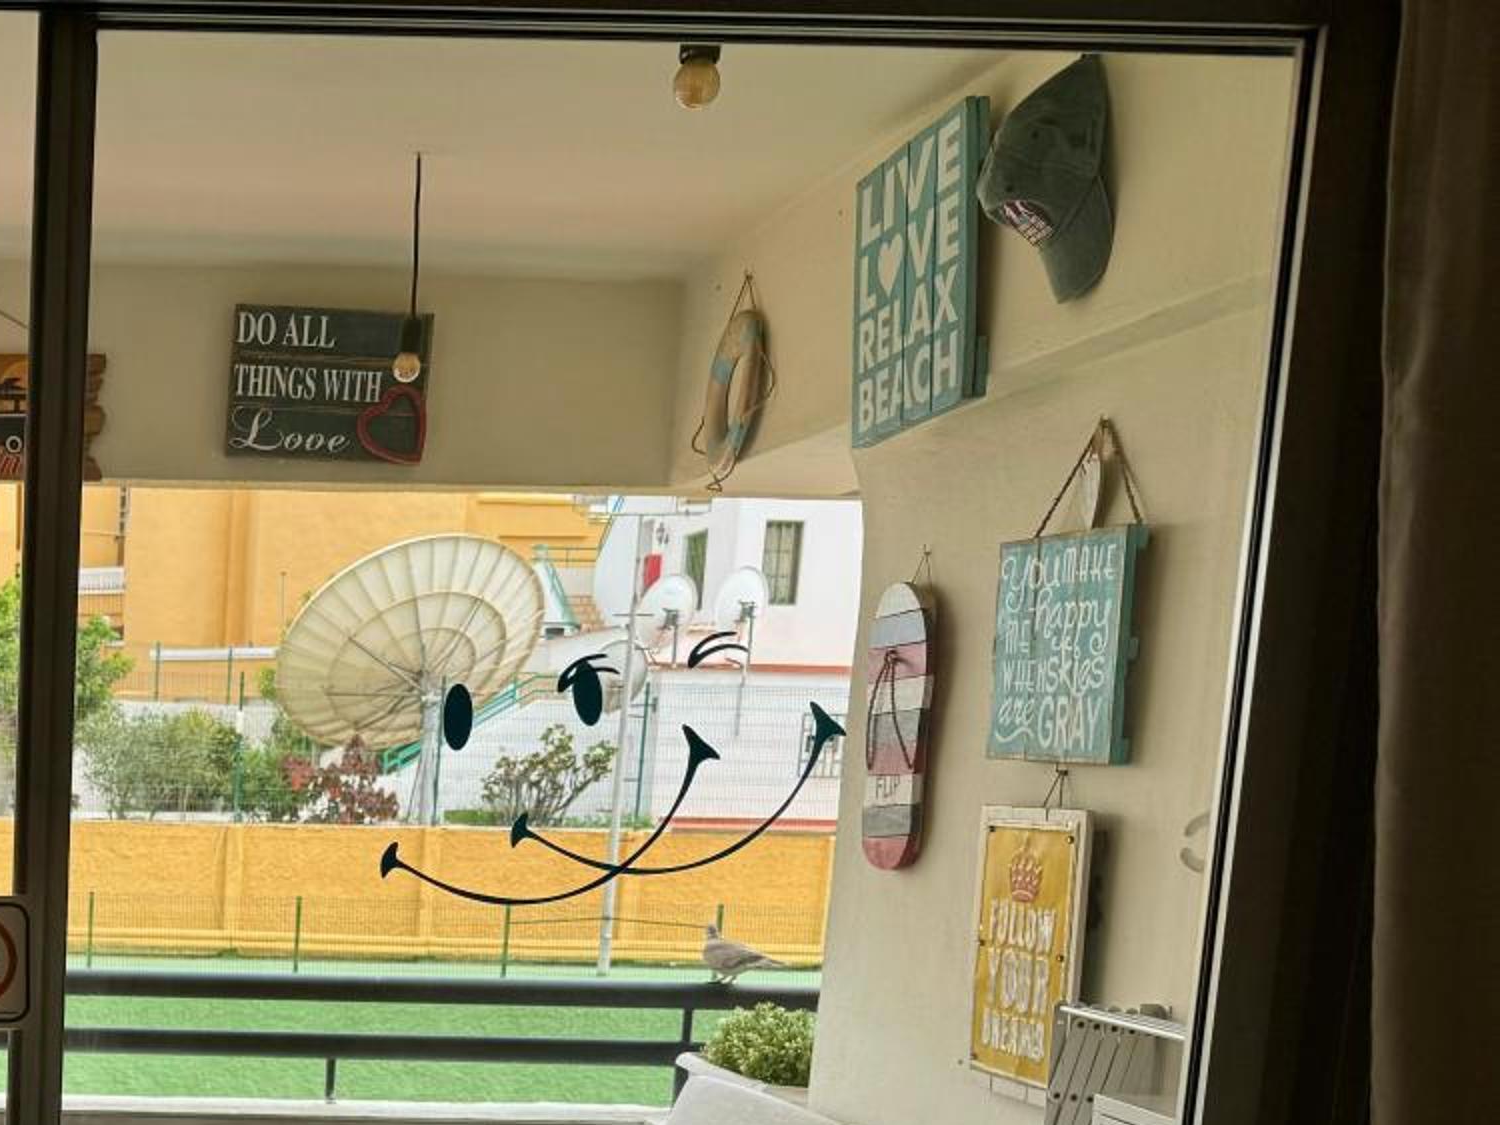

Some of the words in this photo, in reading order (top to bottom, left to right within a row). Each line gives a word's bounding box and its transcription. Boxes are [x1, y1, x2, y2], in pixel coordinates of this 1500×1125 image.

[860, 115, 962, 248] LIVE
[237, 311, 277, 345] DO
[282, 313, 336, 348] ALL
[858, 265, 960, 375] RELAX
[234, 363, 317, 400] THINGS
[323, 369, 382, 403] WITH
[857, 329, 960, 434] BEACH
[228, 405, 351, 452] Love
[1062, 543, 1117, 584] MAKE
[1005, 619, 1031, 655] ME
[1028, 587, 1112, 659] happy
[1003, 658, 1047, 693] WHEN
[998, 696, 1036, 726] are
[1037, 694, 1103, 752] GRAY
[989, 897, 1056, 953] FOLLOW
[987, 946, 1049, 1016] YOUR
[981, 1006, 1045, 1063] DREAMS
